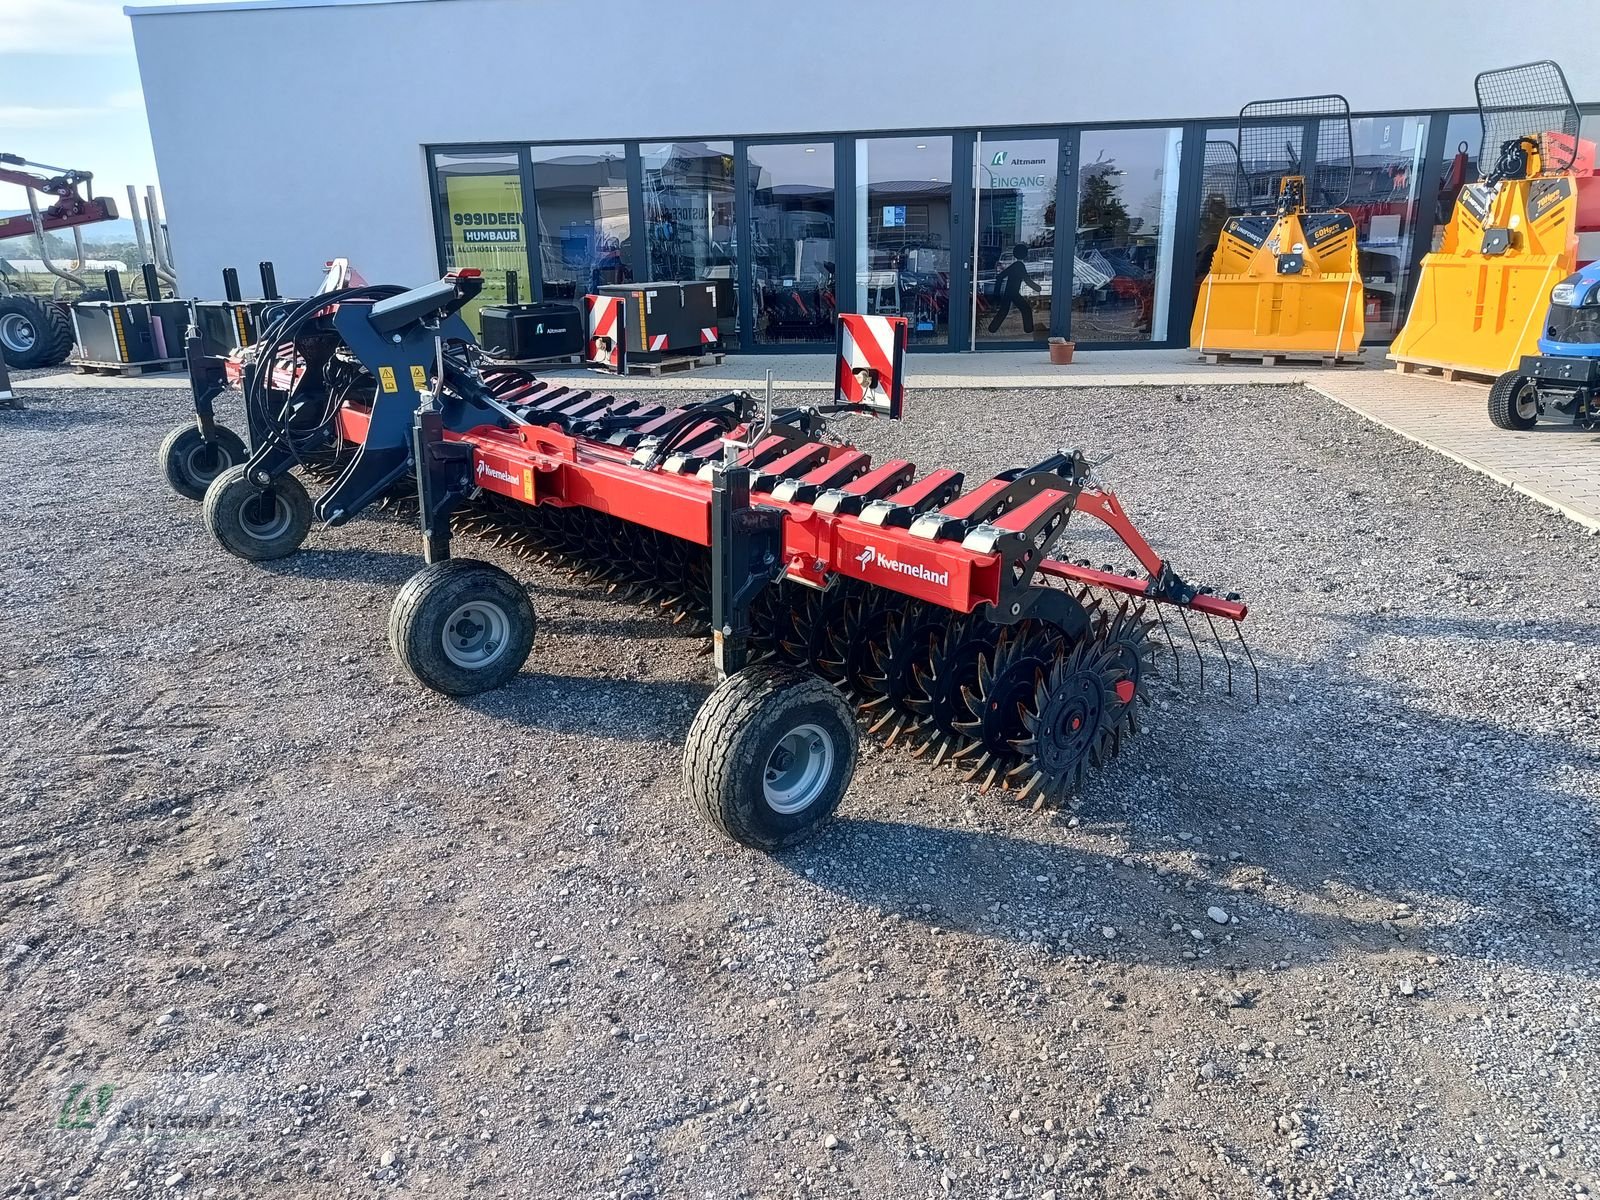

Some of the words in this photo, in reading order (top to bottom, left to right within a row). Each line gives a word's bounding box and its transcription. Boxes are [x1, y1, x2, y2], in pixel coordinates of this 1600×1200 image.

[991, 177, 1045, 188] EINGANG
[465, 231, 518, 241] HUMBAUR
[1236, 226, 1263, 243] UNIFOREST
[485, 464, 520, 486] Kverneland
[877, 552, 949, 587] Kverneland
